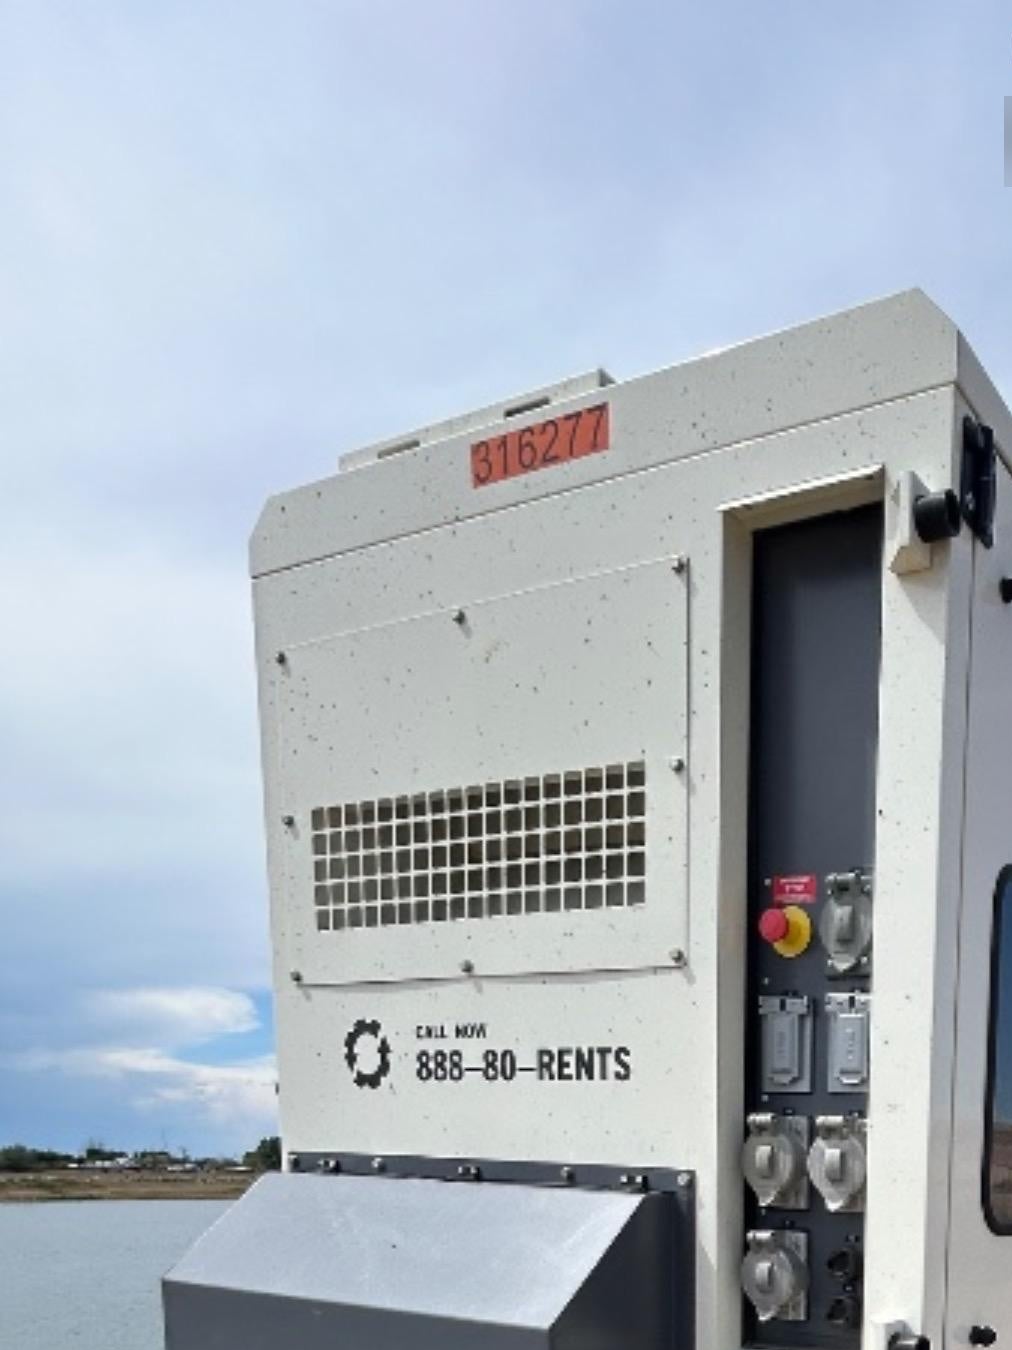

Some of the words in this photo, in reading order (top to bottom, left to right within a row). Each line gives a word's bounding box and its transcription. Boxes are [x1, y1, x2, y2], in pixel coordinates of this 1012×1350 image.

[473, 403, 606, 484] 316277
[455, 1023, 487, 1040] NOW
[416, 1047, 631, 1081] 888-80-RENTS
